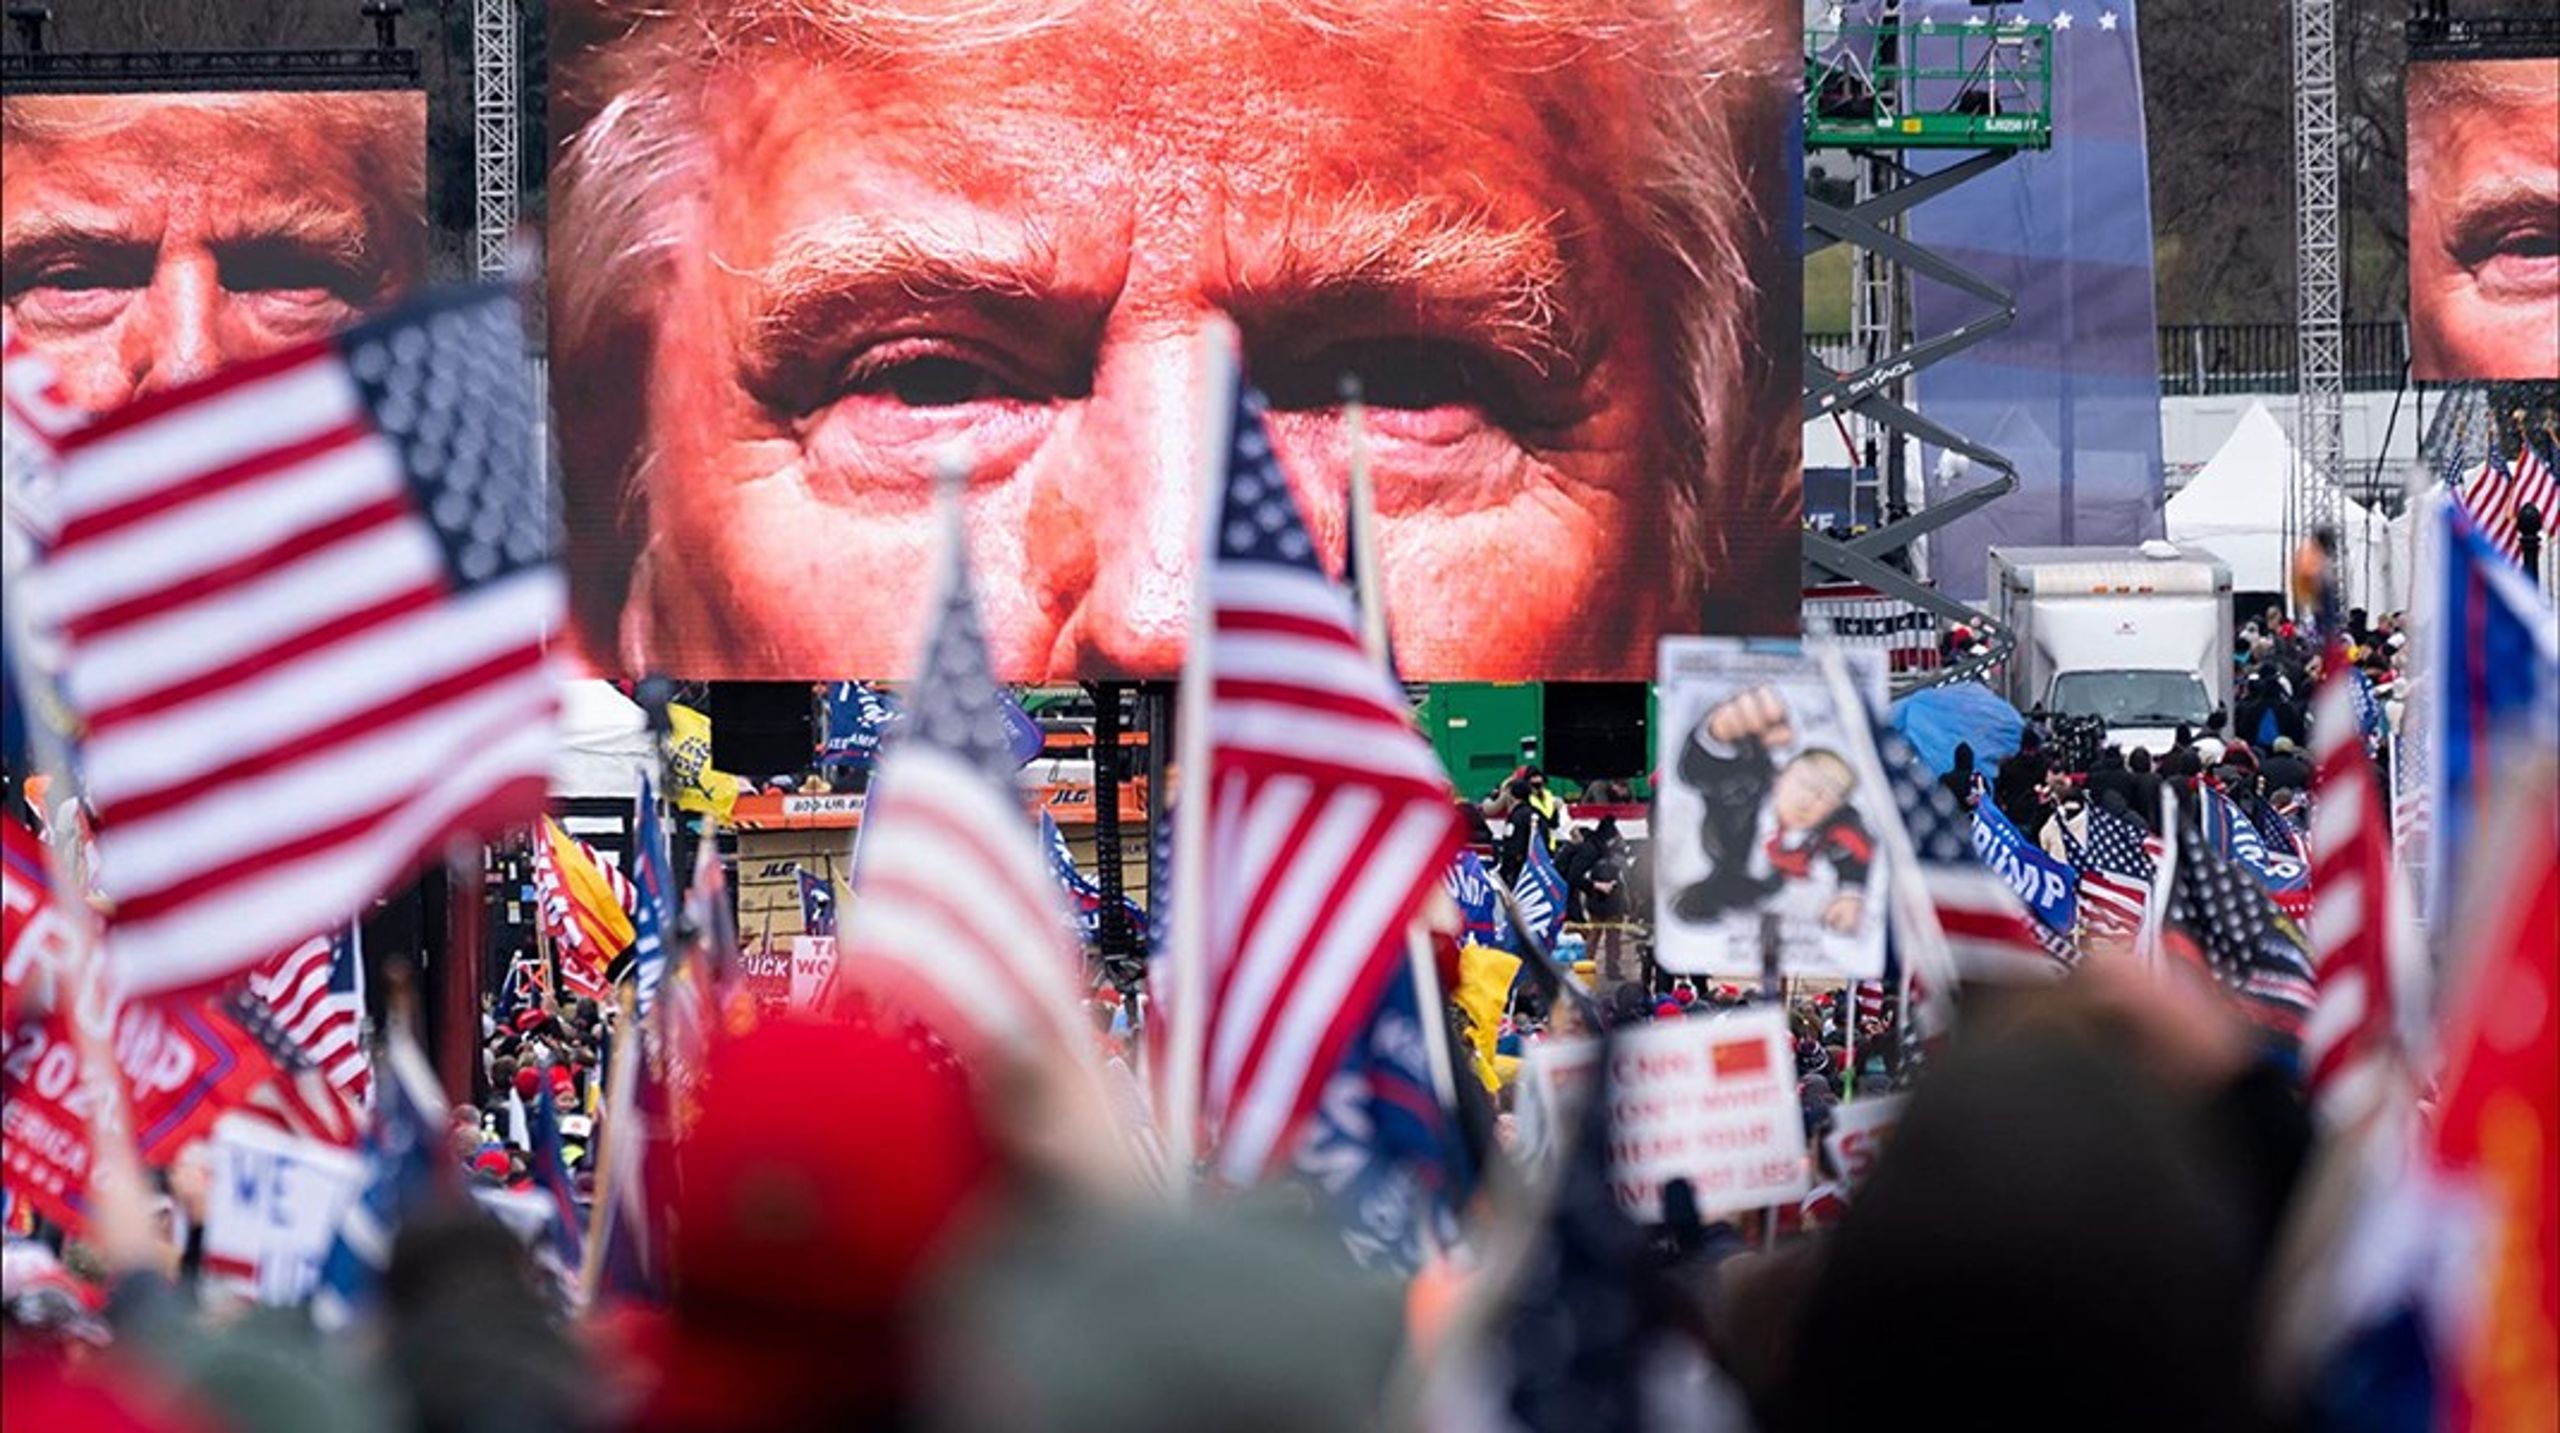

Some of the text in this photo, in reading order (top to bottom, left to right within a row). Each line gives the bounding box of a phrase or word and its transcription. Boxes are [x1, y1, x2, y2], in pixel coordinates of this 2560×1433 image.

[1848, 361, 1914, 395] SKYJACK
[1050, 788, 1089, 805] JLG
[759, 861, 796, 878] JLG
[3, 1103, 87, 1172] ERICA
